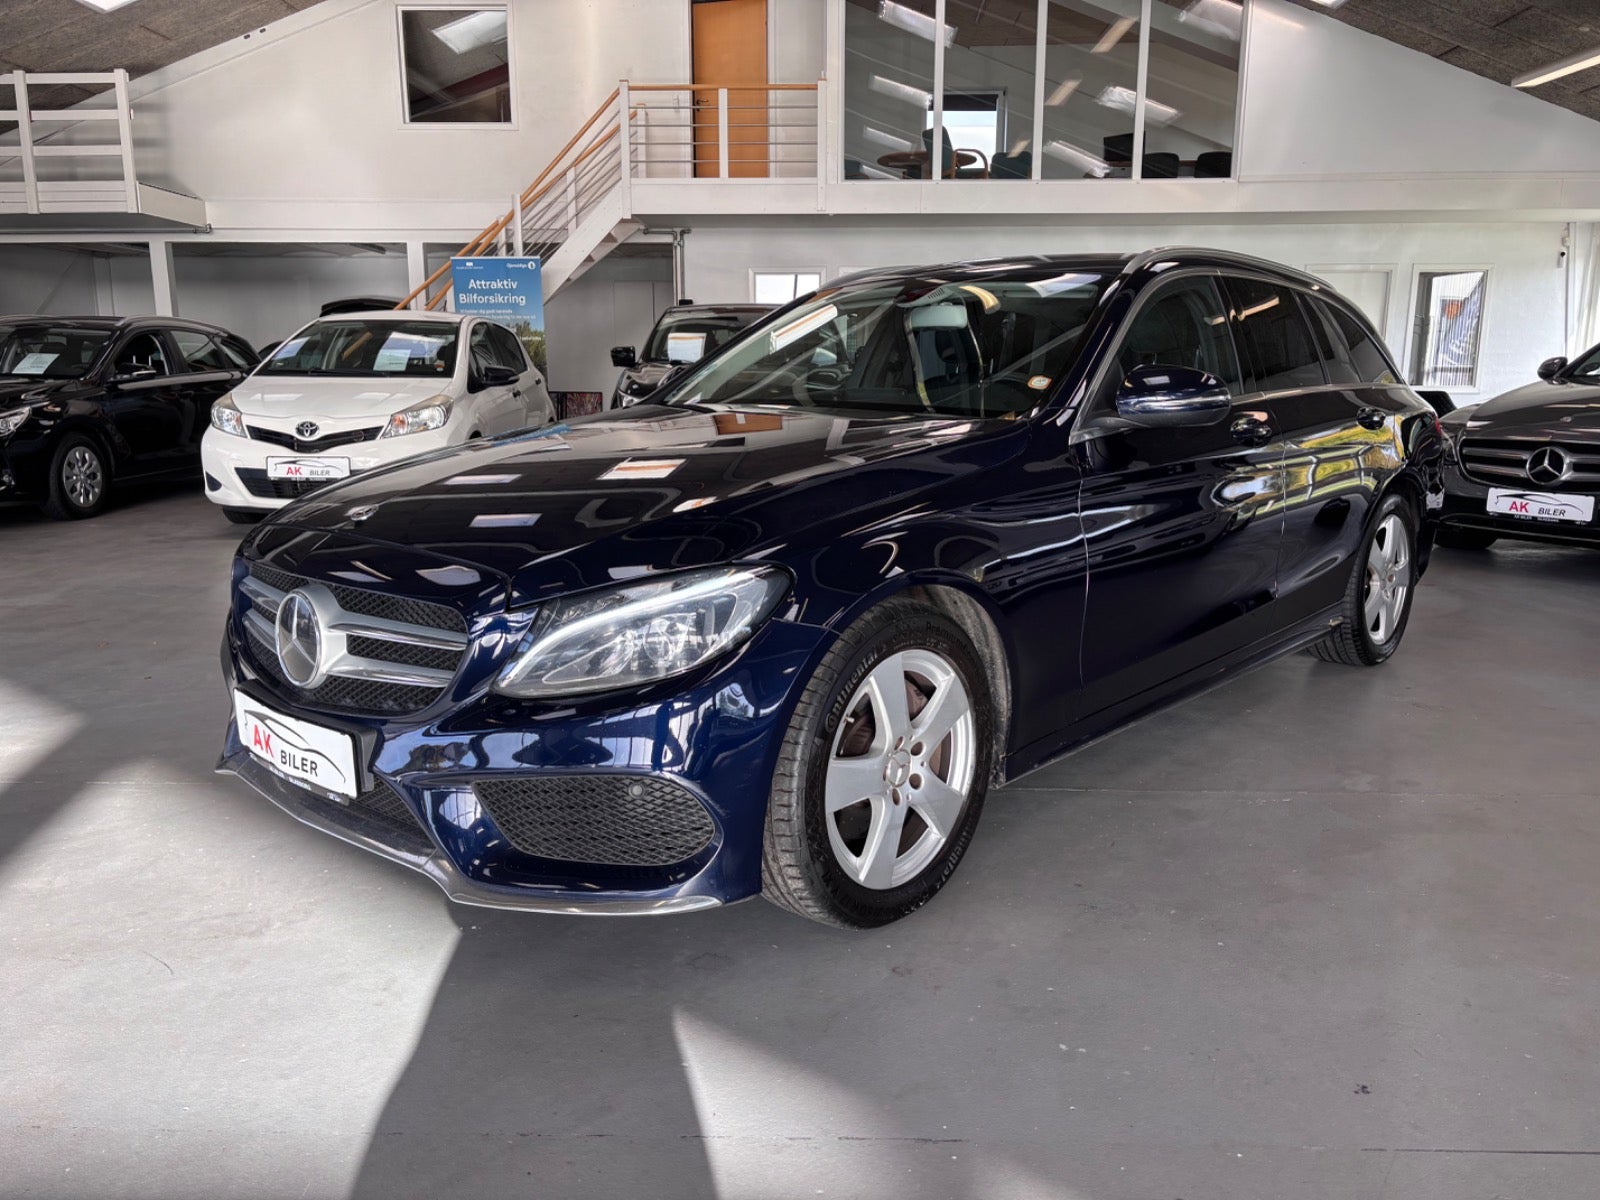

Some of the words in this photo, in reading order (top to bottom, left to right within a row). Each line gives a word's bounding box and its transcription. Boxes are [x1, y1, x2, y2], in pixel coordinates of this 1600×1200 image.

[468, 279, 518, 289] Attraktiv
[459, 293, 526, 306] Bilforsikring
[286, 466, 302, 476] AK
[1509, 501, 1530, 513] AK
[1538, 507, 1566, 517] BILER
[825, 647, 878, 733] Continental
[253, 724, 274, 758] AK
[280, 750, 318, 777] BILER
